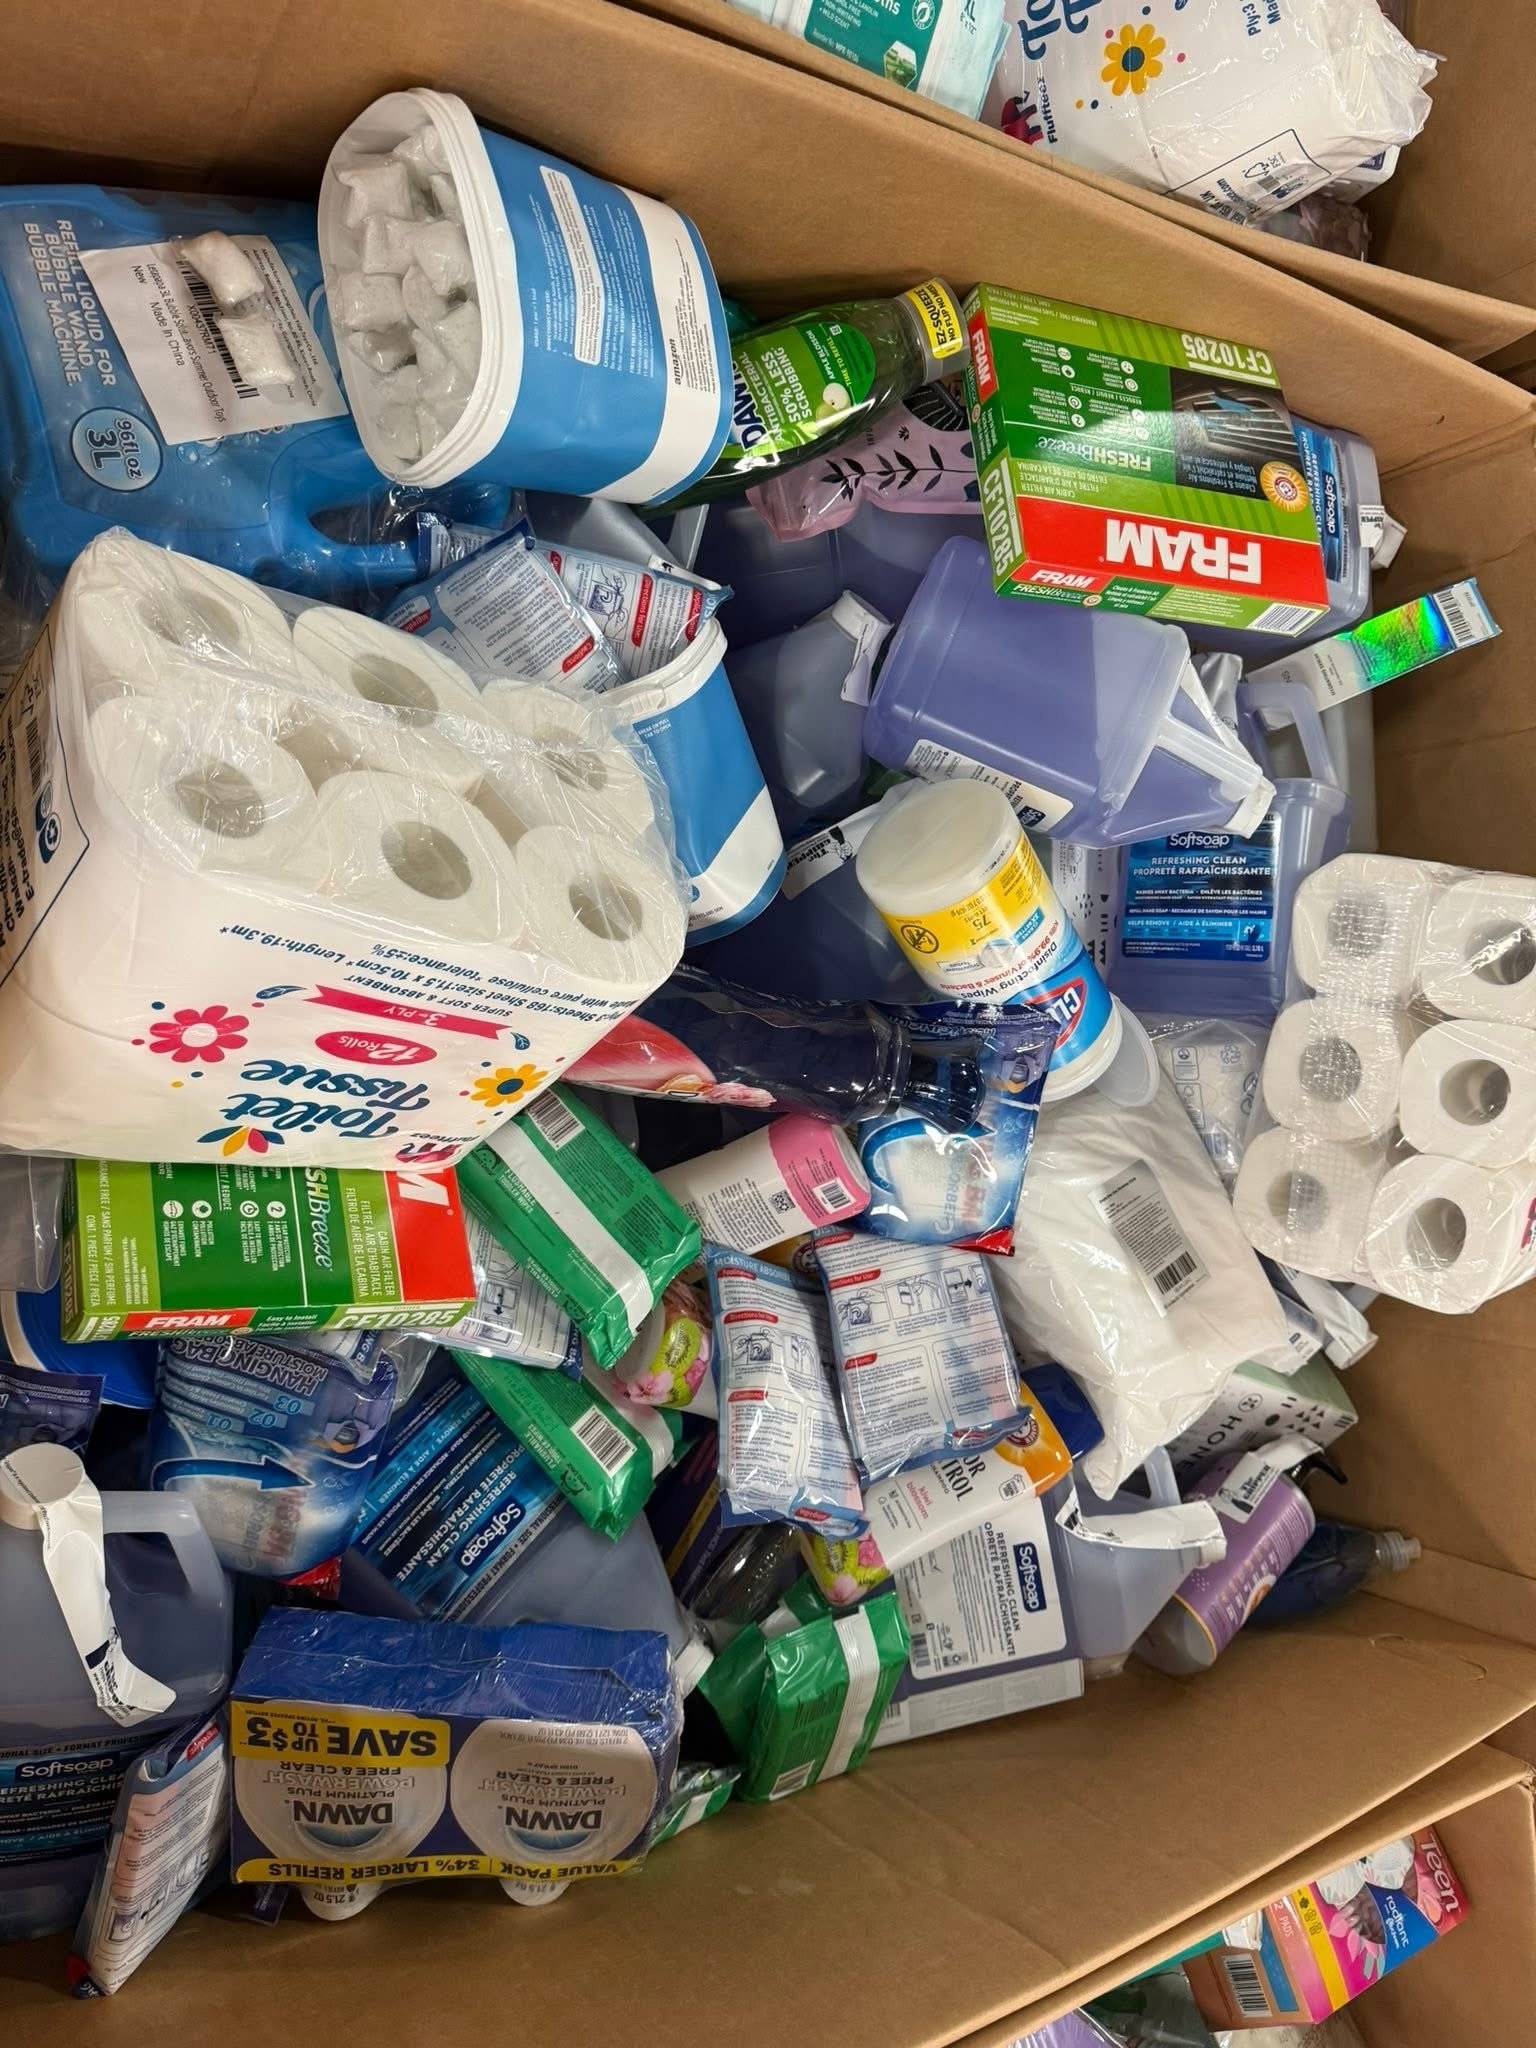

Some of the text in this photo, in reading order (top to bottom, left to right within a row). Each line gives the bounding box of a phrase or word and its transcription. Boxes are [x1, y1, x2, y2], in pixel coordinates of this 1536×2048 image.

[1240, 1, 1264, 36] Ply:3
[42, 230, 77, 305] BUBBLE
[22, 219, 83, 387] BUBBLE MACHINE.
[56, 216, 117, 388] REFILL LIQUID FOR
[131, 262, 187, 367] New Made China
[914, 285, 951, 346] EZ-SQUEEZE
[935, 296, 957, 341] NO FLIP NO
[662, 336, 686, 386] amazon
[805, 327, 836, 380] APPLE BLOSSOM
[825, 334, 853, 386] TIME TO REFILL
[971, 327, 991, 386] FRAM
[1176, 330, 1276, 376] CF10285
[201, 380, 228, 423] Outdoor Toys
[737, 350, 787, 444] ANTIBACTERIAL
[760, 349, 802, 424] 50% LESS
[86, 422, 124, 470] 3L
[1035, 433, 1153, 472] FRESHBreeze
[123, 455, 143, 480] oz
[1186, 472, 1256, 492] Cleans Freshens Air
[1305, 452, 1326, 512] REFRESHING
[1020, 481, 1075, 498] CABIN AIR FILTER
[1317, 473, 1343, 534] Softsoap
[983, 470, 1014, 576] CF10285
[1099, 513, 1268, 590] FRAM
[1030, 568, 1094, 589] FRAM
[1169, 831, 1230, 848] Softsoap
[1133, 864, 1270, 875] PROPRETÉ RAFRAÎCHISSANTE
[1212, 856, 1246, 864] CLEAN
[970, 909, 993, 934] 75
[959, 939, 1057, 1000] Disinfecting Wipes
[342, 972, 513, 1019] SUPER SOFT & ABSORBENT
[423, 973, 596, 1024] Sheets:168 Sheet size:11.5
[486, 973, 608, 1010] with pure cellulose
[336, 1032, 420, 1066] 12 Rolls
[238, 1051, 434, 1118] Tissue
[216, 1082, 400, 1150] Toilet
[221, 1184, 231, 1210] REDUCE
[503, 1168, 538, 1206] FLUSHABLE
[516, 1195, 535, 1214] WIPES
[99, 1189, 115, 1304] FREE SANS PARFUM SIN PERFUME
[206, 1220, 214, 1244] POLLUTION
[346, 1188, 368, 1296] FILTRO DE AIRE DE LA CABINA
[360, 1201, 382, 1296] FILTRE AIR D'HABITACLE
[85, 1214, 99, 1306] CONT. PIECE PIEZA
[164, 1244, 172, 1261] ESCAPE
[378, 1231, 395, 1296] CABIN AIR FILTER
[144, 1314, 230, 1328] FRAM
[334, 1309, 461, 1328] CF10285
[168, 1334, 316, 1396] HANGING BAG
[252, 1343, 328, 1381] MOISTURE
[206, 1413, 232, 1430] 01
[246, 1406, 277, 1429] 02
[272, 1393, 303, 1416] 03
[521, 1429, 558, 1470] FLUSHABLE
[376, 1448, 431, 1505] AIDE ÉLIMINER
[917, 1485, 933, 1506] kiwi
[1238, 1475, 1255, 1493] The
[1240, 1463, 1273, 1501] GRIPPER
[394, 1442, 527, 1582] PROPRETÉ RAFRAÎCHISSANTE
[425, 1469, 518, 1567] REFRESHING CLEAN
[905, 1481, 930, 1520] blossom
[455, 1498, 524, 1570] Softsoap
[488, 1528, 533, 1576] SIZE FORMAT
[995, 1532, 1021, 1631] REFRESHING CLEAN
[1015, 1544, 1044, 1610] Softsoap
[990, 1564, 1017, 1656] RAFRAÎCHISSANTE
[290, 1721, 318, 1737] TO
[290, 1736, 319, 1752] UP
[325, 1724, 436, 1756] SAVE
[20, 1757, 114, 1778] Softsoap
[262, 1770, 414, 1789] POWERWASH
[278, 1759, 400, 1776] FREE & CLEAR
[494, 1769, 613, 1785] FREE & CLEAR
[286, 1786, 395, 1799] PLATINUM PLUS
[477, 1778, 625, 1798] POWERWASH
[500, 1794, 606, 1806] PLATINUM PLUS
[290, 1799, 393, 1824] DAWN
[503, 1805, 601, 1829] DAWN
[267, 1857, 619, 1880] VALUE PACK 34% LARGER REFILLS
[1419, 1831, 1460, 1912] Teen
[325, 1891, 346, 1904] 21.5
[1277, 1914, 1295, 1938] PADS
[1384, 1894, 1410, 1948] radiant
